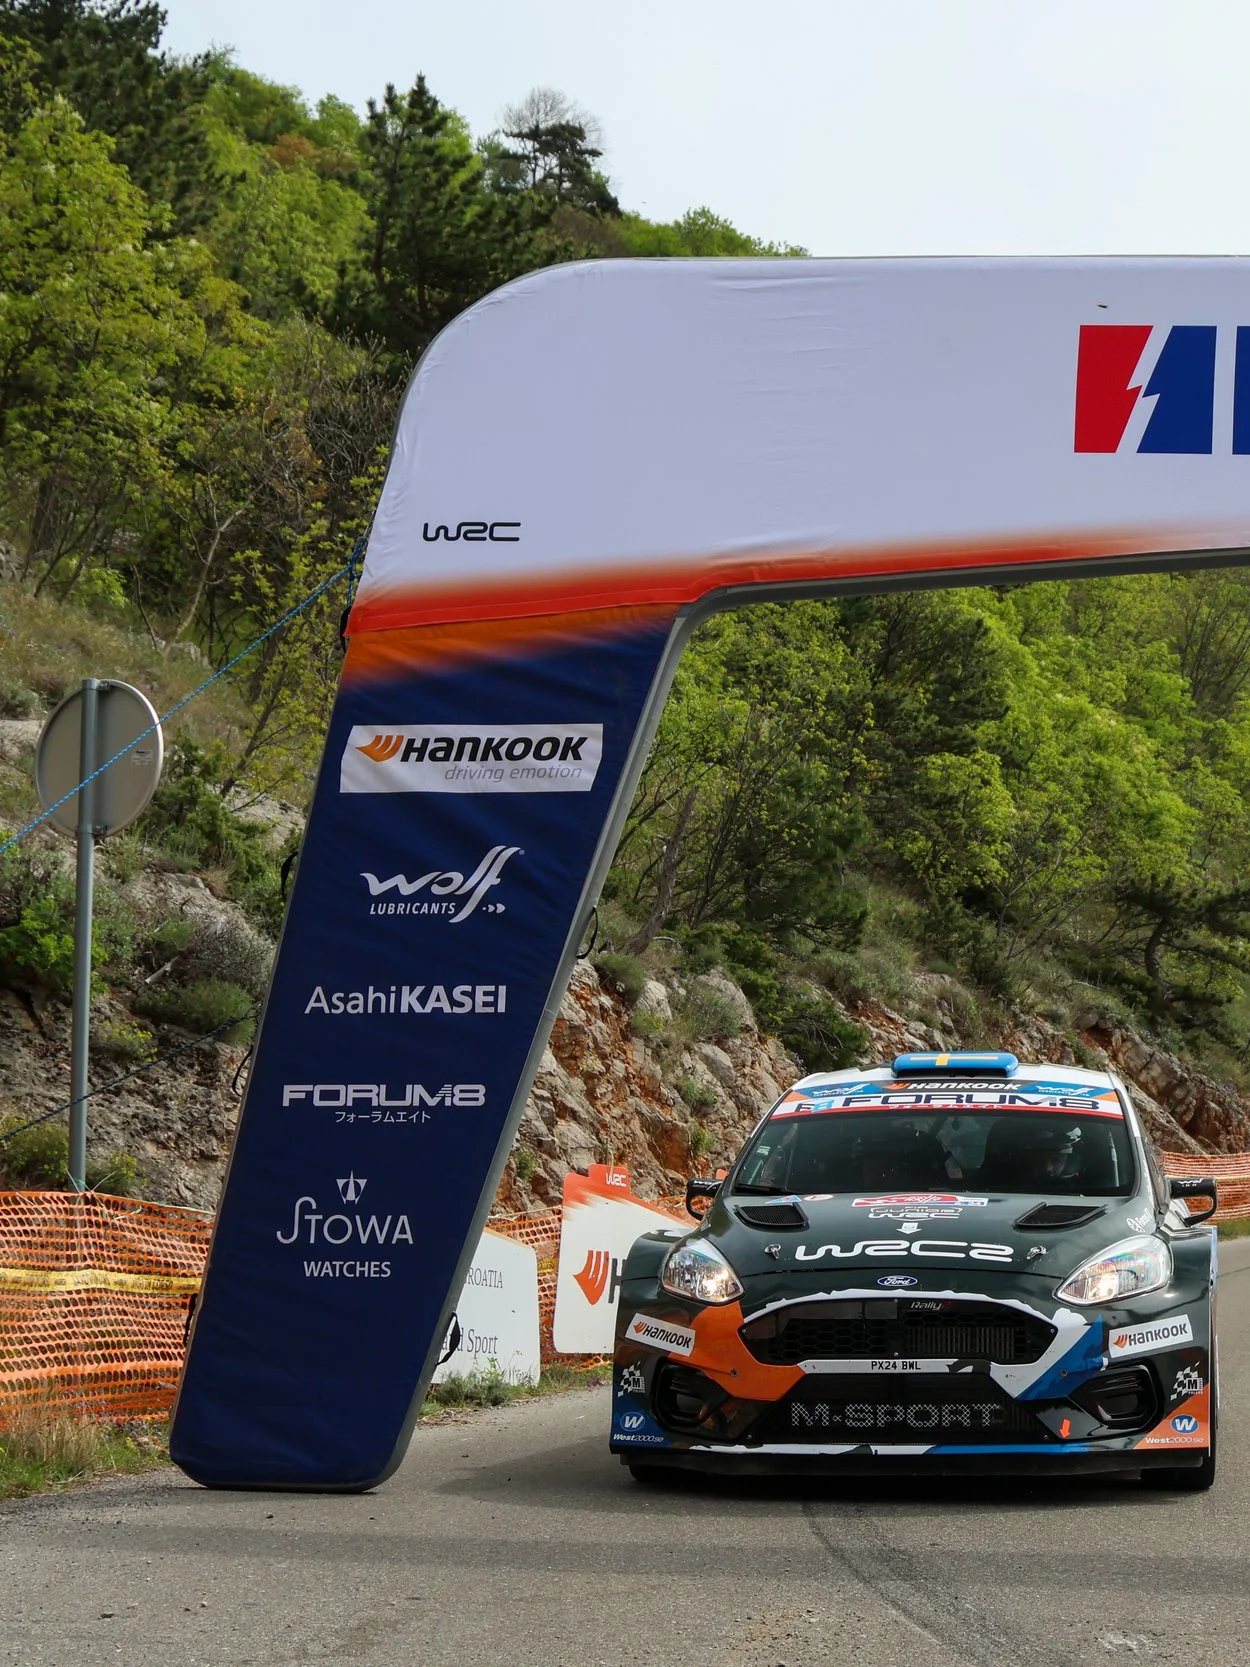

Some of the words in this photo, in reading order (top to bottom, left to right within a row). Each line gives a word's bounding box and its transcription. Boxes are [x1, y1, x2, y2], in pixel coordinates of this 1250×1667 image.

[423, 522, 521, 541] WRC
[444, 765, 504, 783] driving
[510, 765, 582, 780] emotion
[369, 902, 456, 915] LUBRICANTS
[282, 1084, 486, 1107] FORUM8
[841, 1093, 1100, 1110] FORUM8
[334, 1111, 431, 1123] フォーラムエイト
[606, 1173, 627, 1188] WRC
[276, 1196, 414, 1244] STOWA
[795, 1239, 1014, 1263] WRC2
[303, 1261, 391, 1278] WATCHES
[465, 1267, 503, 1289] ROATIA
[883, 1276, 911, 1286] Ford
[466, 1328, 498, 1360] Sport
[871, 1360, 898, 1370] PX24
[901, 1360, 921, 1370] BWL
[624, 1415, 645, 1428] W
[1175, 1416, 1196, 1431] W
